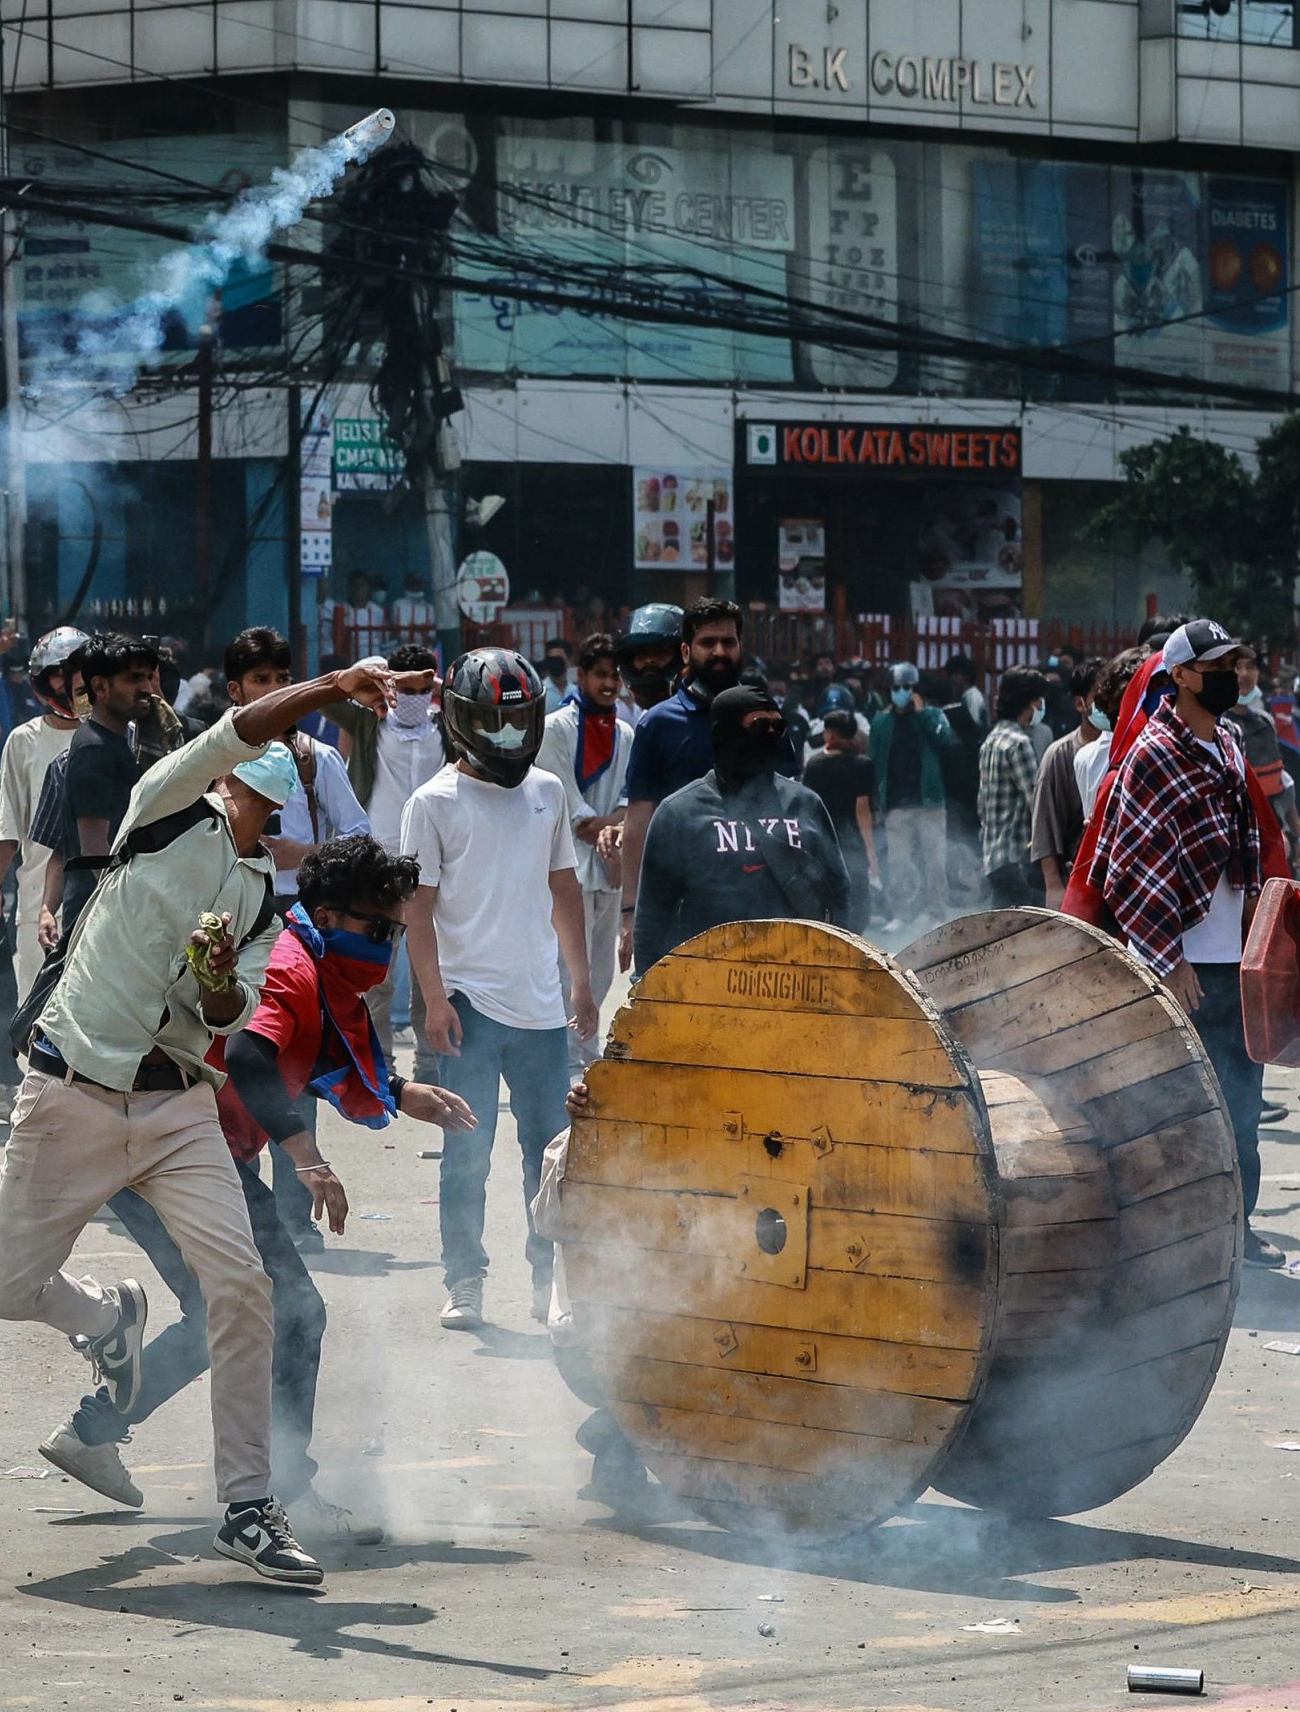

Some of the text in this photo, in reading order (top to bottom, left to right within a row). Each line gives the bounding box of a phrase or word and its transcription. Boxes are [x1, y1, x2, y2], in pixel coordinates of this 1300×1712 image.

[788, 43, 1038, 109] B.K COMPLEX
[608, 187, 667, 234] EYE
[674, 192, 791, 242] CENTER
[1211, 208, 1278, 231] DIABETES
[783, 427, 1019, 468] KOLKATA SWEETS
[727, 967, 830, 1004] CONSIGNEE
